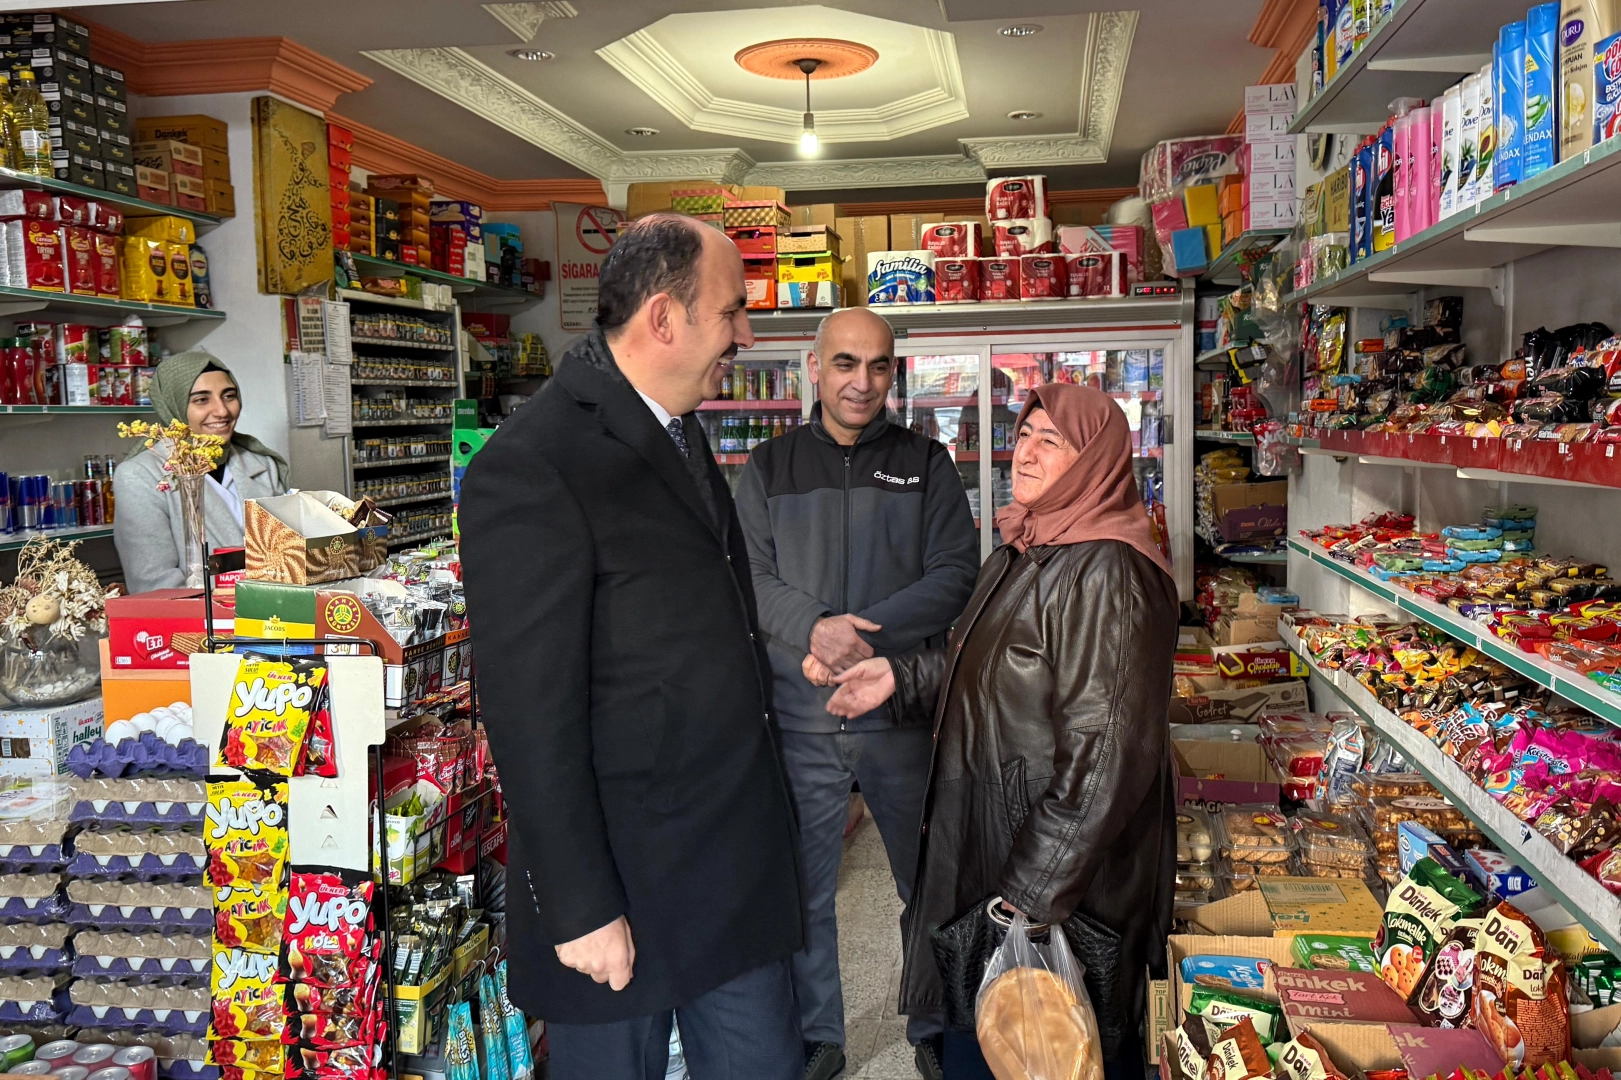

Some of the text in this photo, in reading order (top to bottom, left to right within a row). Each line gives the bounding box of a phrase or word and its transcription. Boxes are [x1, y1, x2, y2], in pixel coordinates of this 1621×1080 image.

[1562, 22, 1581, 41] DURU
[154, 128, 188, 138] Dankek
[875, 257, 928, 280] familia
[457, 407, 475, 415] mentos
[219, 574, 240, 582] NAPO
[264, 624, 286, 632] JACOBS
[267, 671, 293, 681] ÜLKER
[1196, 701, 1228, 717] Gofret
[73, 726, 102, 743] halley
[1399, 885, 1442, 923] Dankek
[1278, 975, 1367, 993] ankek
